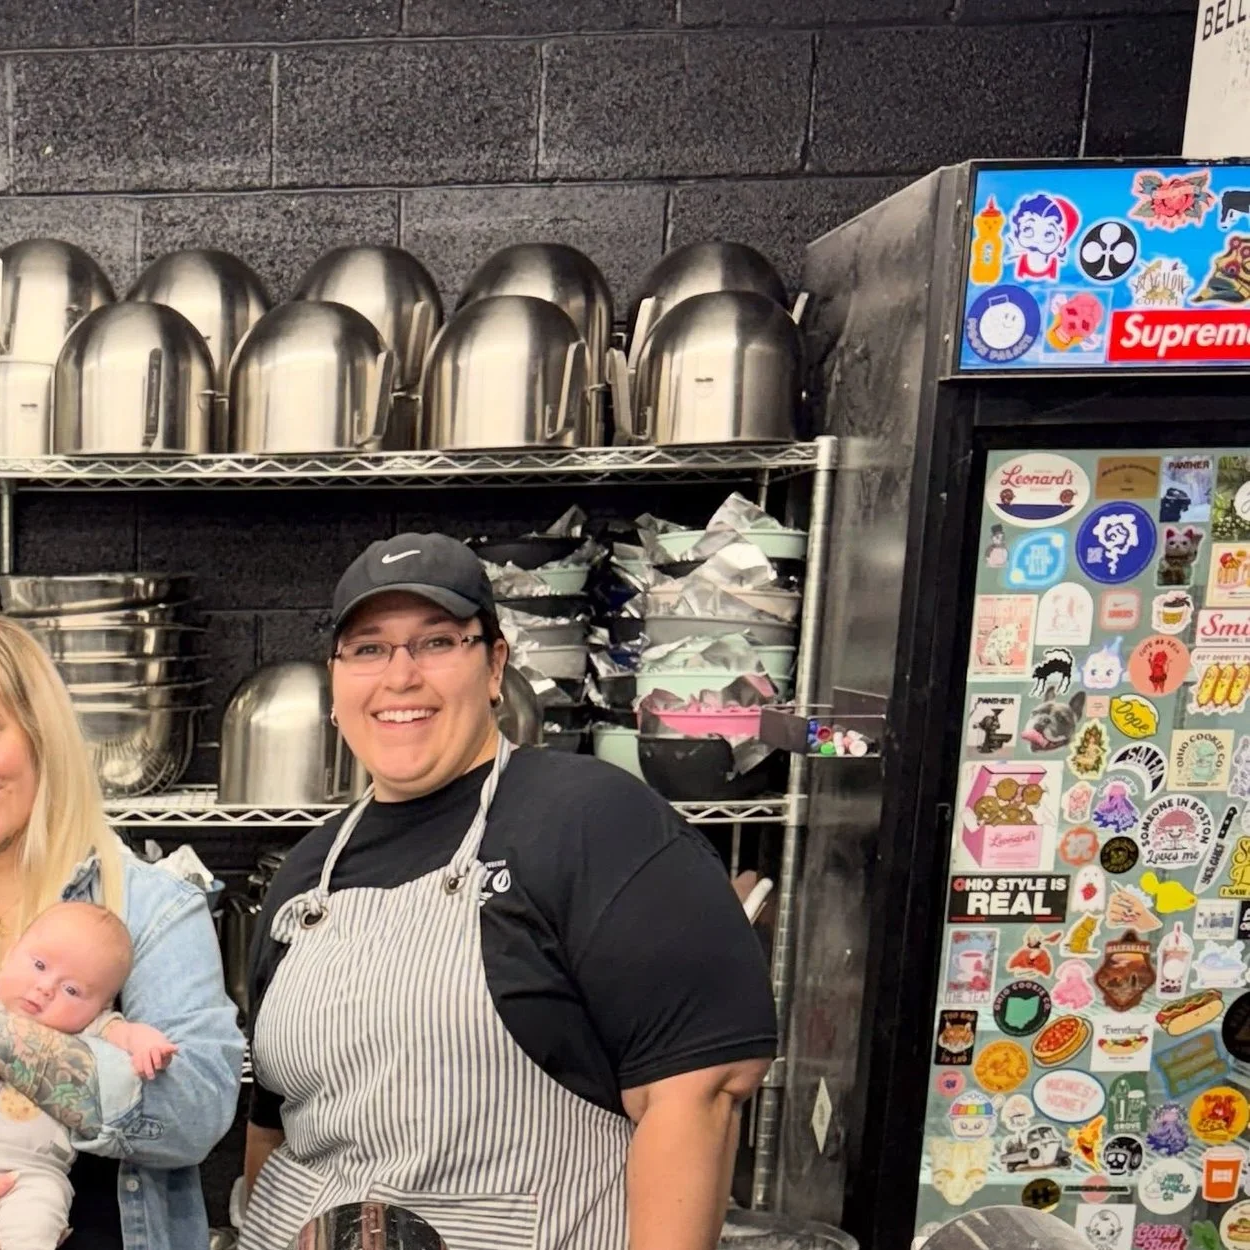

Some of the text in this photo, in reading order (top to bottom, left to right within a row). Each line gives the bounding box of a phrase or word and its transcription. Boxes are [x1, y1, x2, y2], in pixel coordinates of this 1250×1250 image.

[1119, 313, 1250, 358] Suprem
[1000, 464, 1074, 488] Leonard's
[1168, 461, 1210, 470] PANTHER
[1116, 701, 1150, 734] Dope
[1176, 741, 1189, 768] OHIO
[1189, 733, 1225, 752] COOKIE
[1140, 798, 1174, 848] SOMEONE
[1177, 798, 1190, 807] IN
[1190, 801, 1212, 845] BOSTON
[1182, 850, 1200, 861] me
[953, 877, 1066, 892] OHIO STYLE IS
[966, 891, 1052, 916] REAL
[994, 989, 1010, 1011] OHIO
[1012, 982, 1047, 999] COOKIE
[1135, 1224, 1180, 1243] Gone
